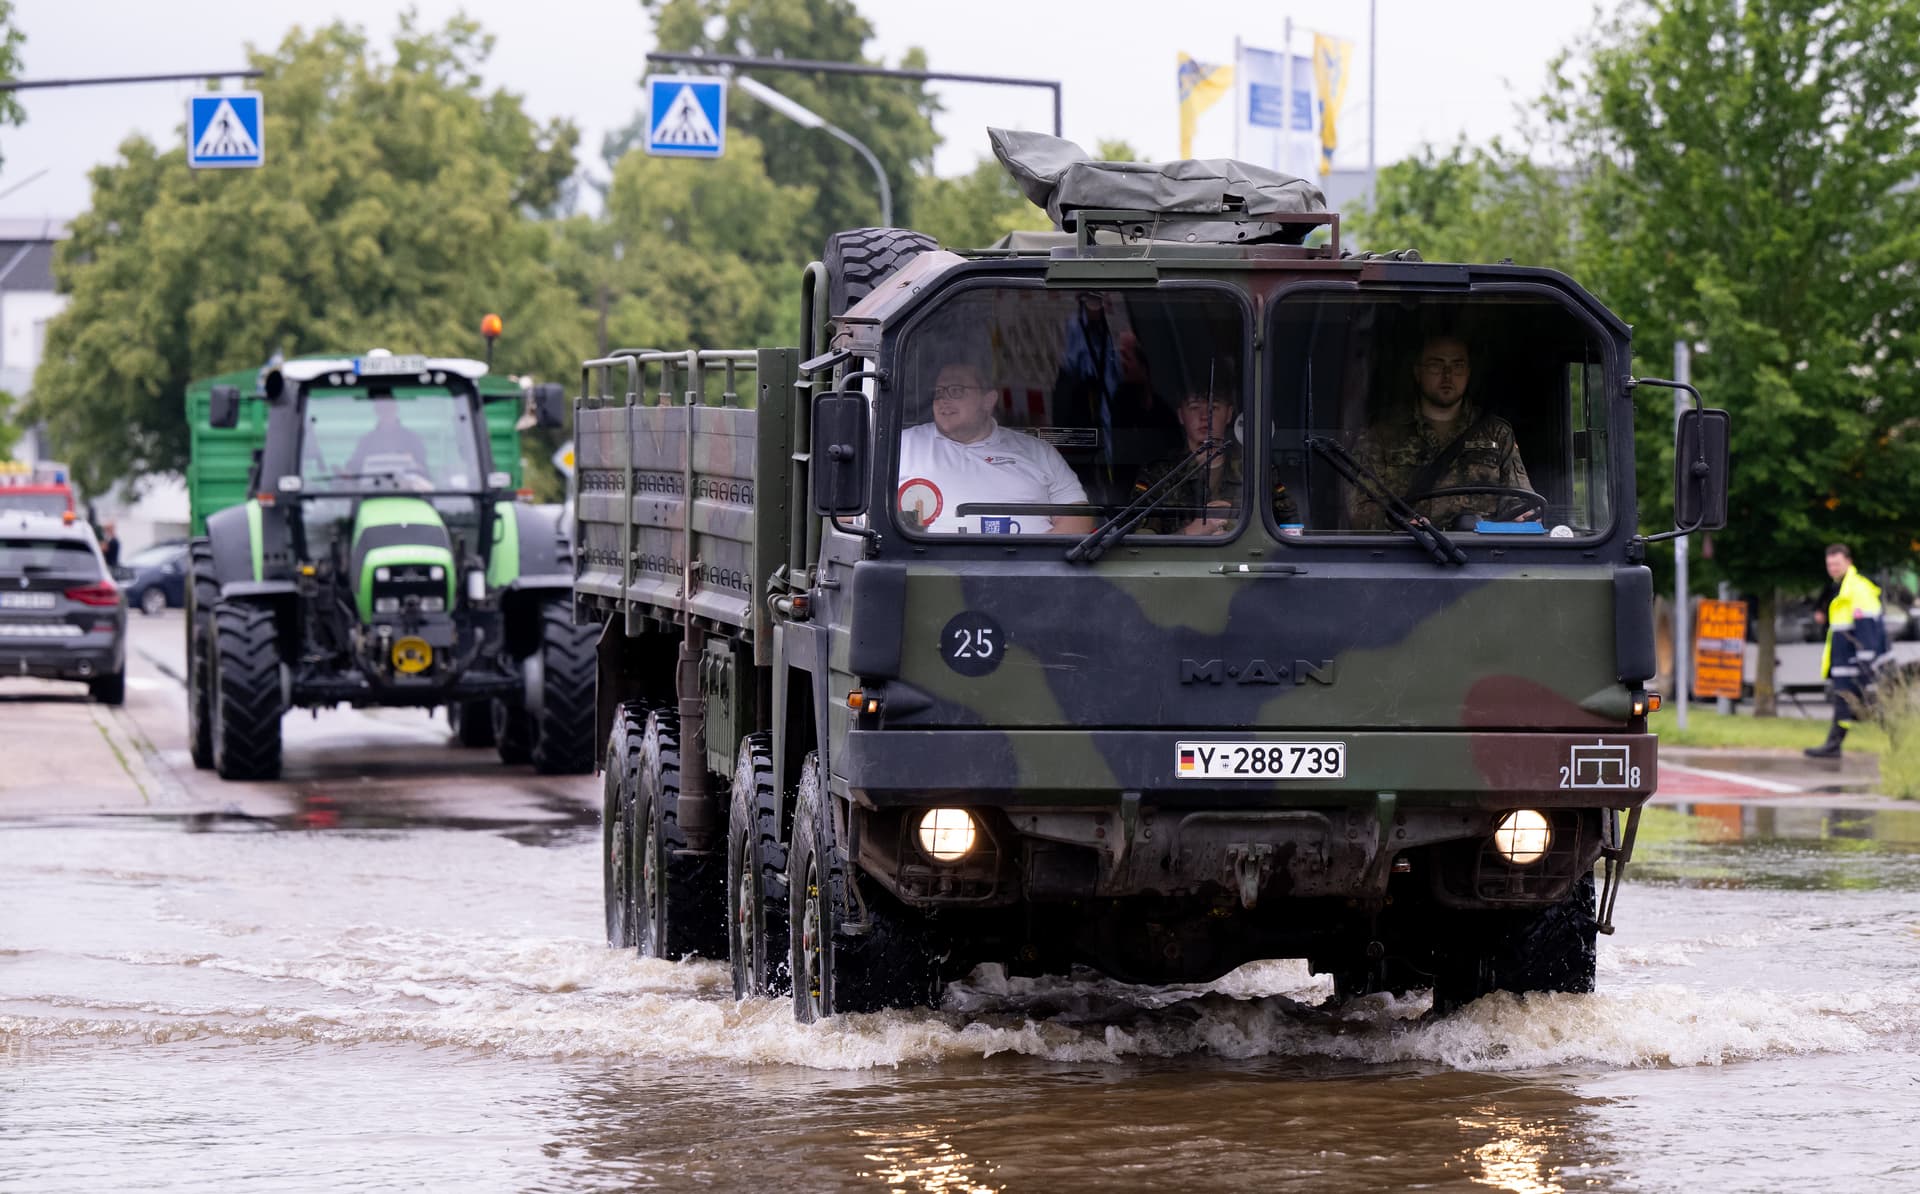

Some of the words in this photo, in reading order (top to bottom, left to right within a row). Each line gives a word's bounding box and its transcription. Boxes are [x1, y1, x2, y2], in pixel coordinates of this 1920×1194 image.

[953, 628, 993, 658] 25
[1559, 766, 1570, 789] 2
[1630, 766, 1641, 788] 8
